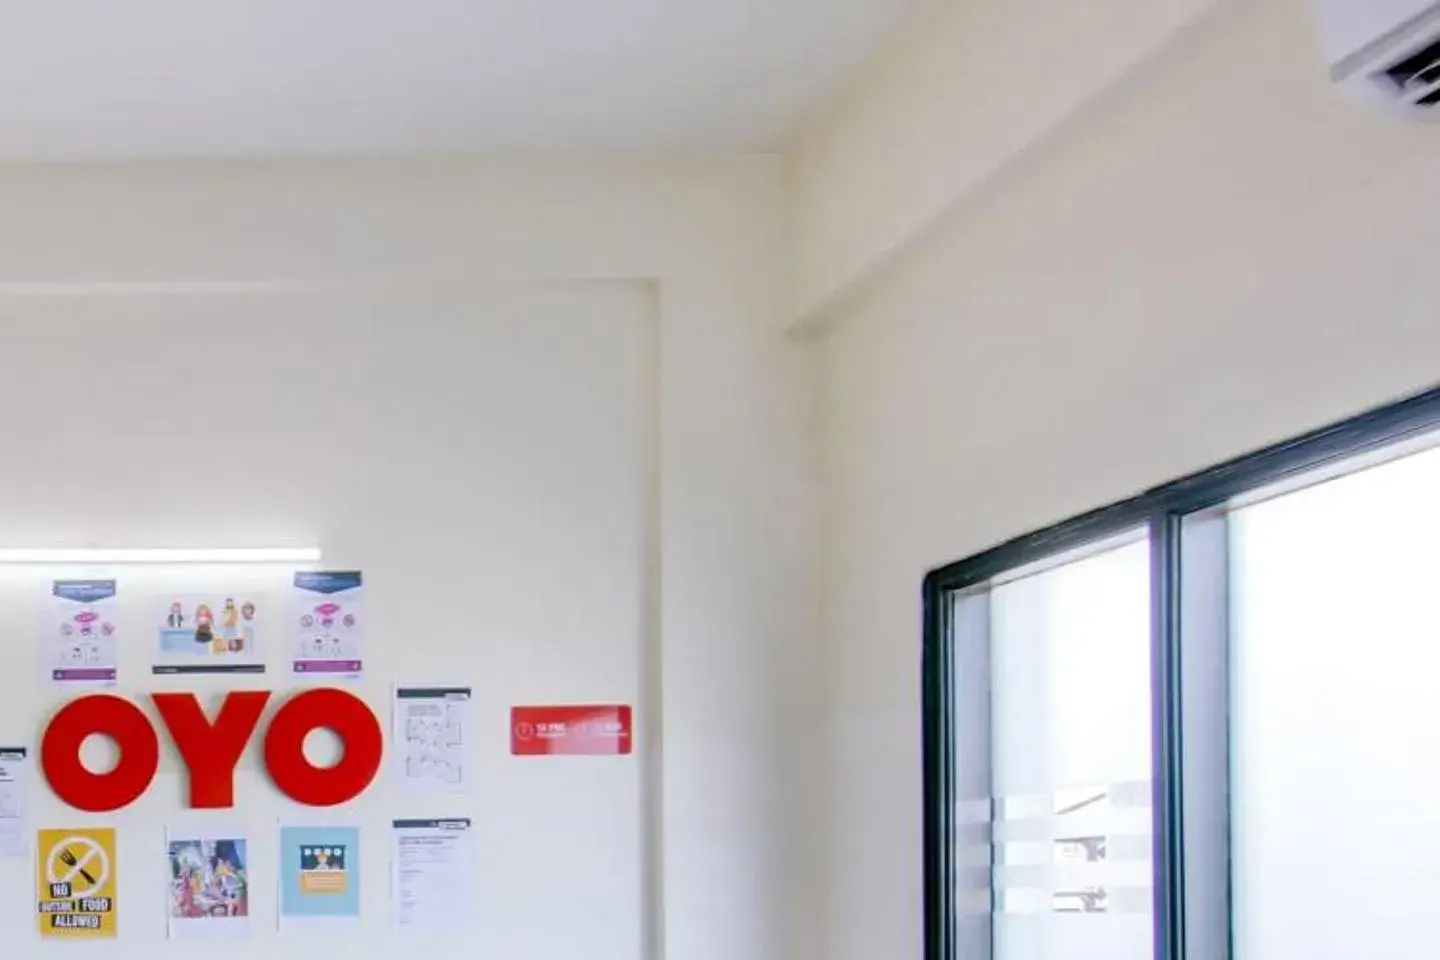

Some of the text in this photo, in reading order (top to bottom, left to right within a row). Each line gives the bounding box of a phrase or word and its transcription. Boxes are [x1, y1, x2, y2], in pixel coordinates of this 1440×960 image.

[41, 687, 383, 812] OYO
[53, 883, 68, 896] NO
[82, 898, 108, 911] FOOD
[55, 914, 99, 927] ALLOWED
